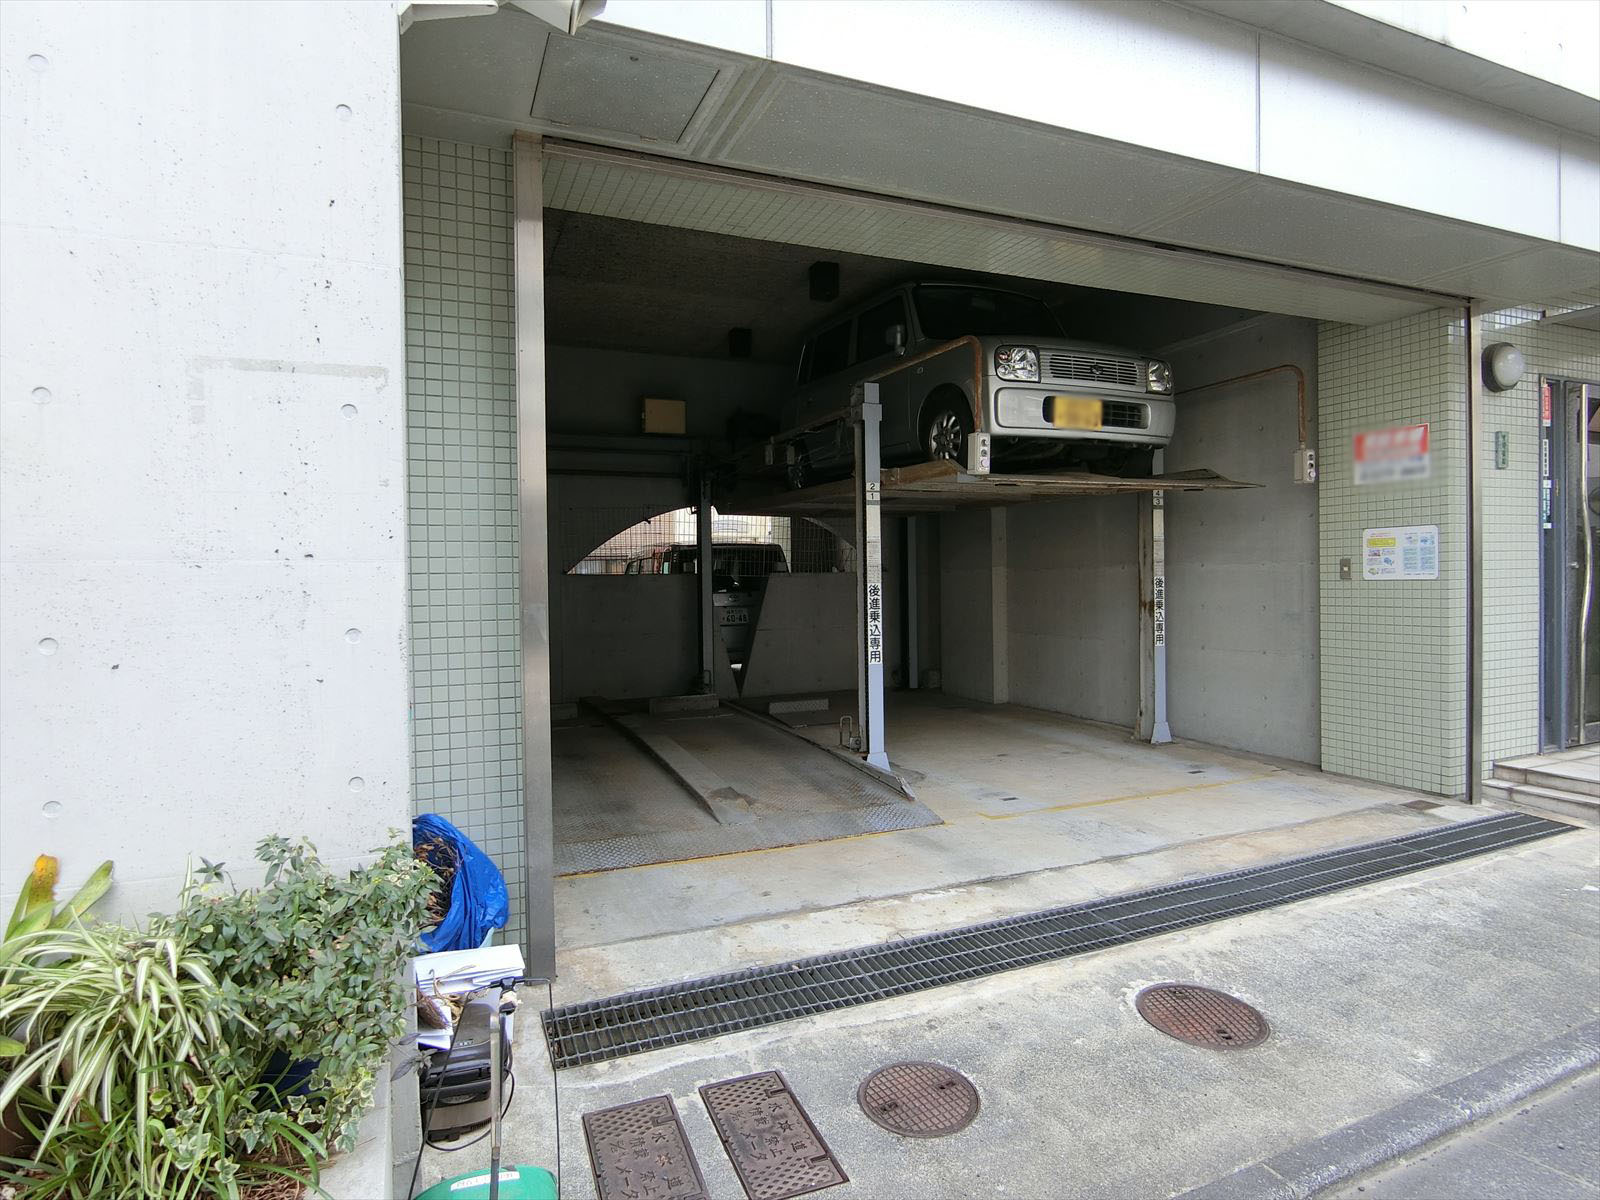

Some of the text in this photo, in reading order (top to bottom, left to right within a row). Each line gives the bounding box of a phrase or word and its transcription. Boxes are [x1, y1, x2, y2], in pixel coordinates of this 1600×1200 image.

[869, 483, 876, 491] 2
[868, 585, 881, 663] 後進乗込専用
[1154, 577, 1164, 645] 後進乗込専用
